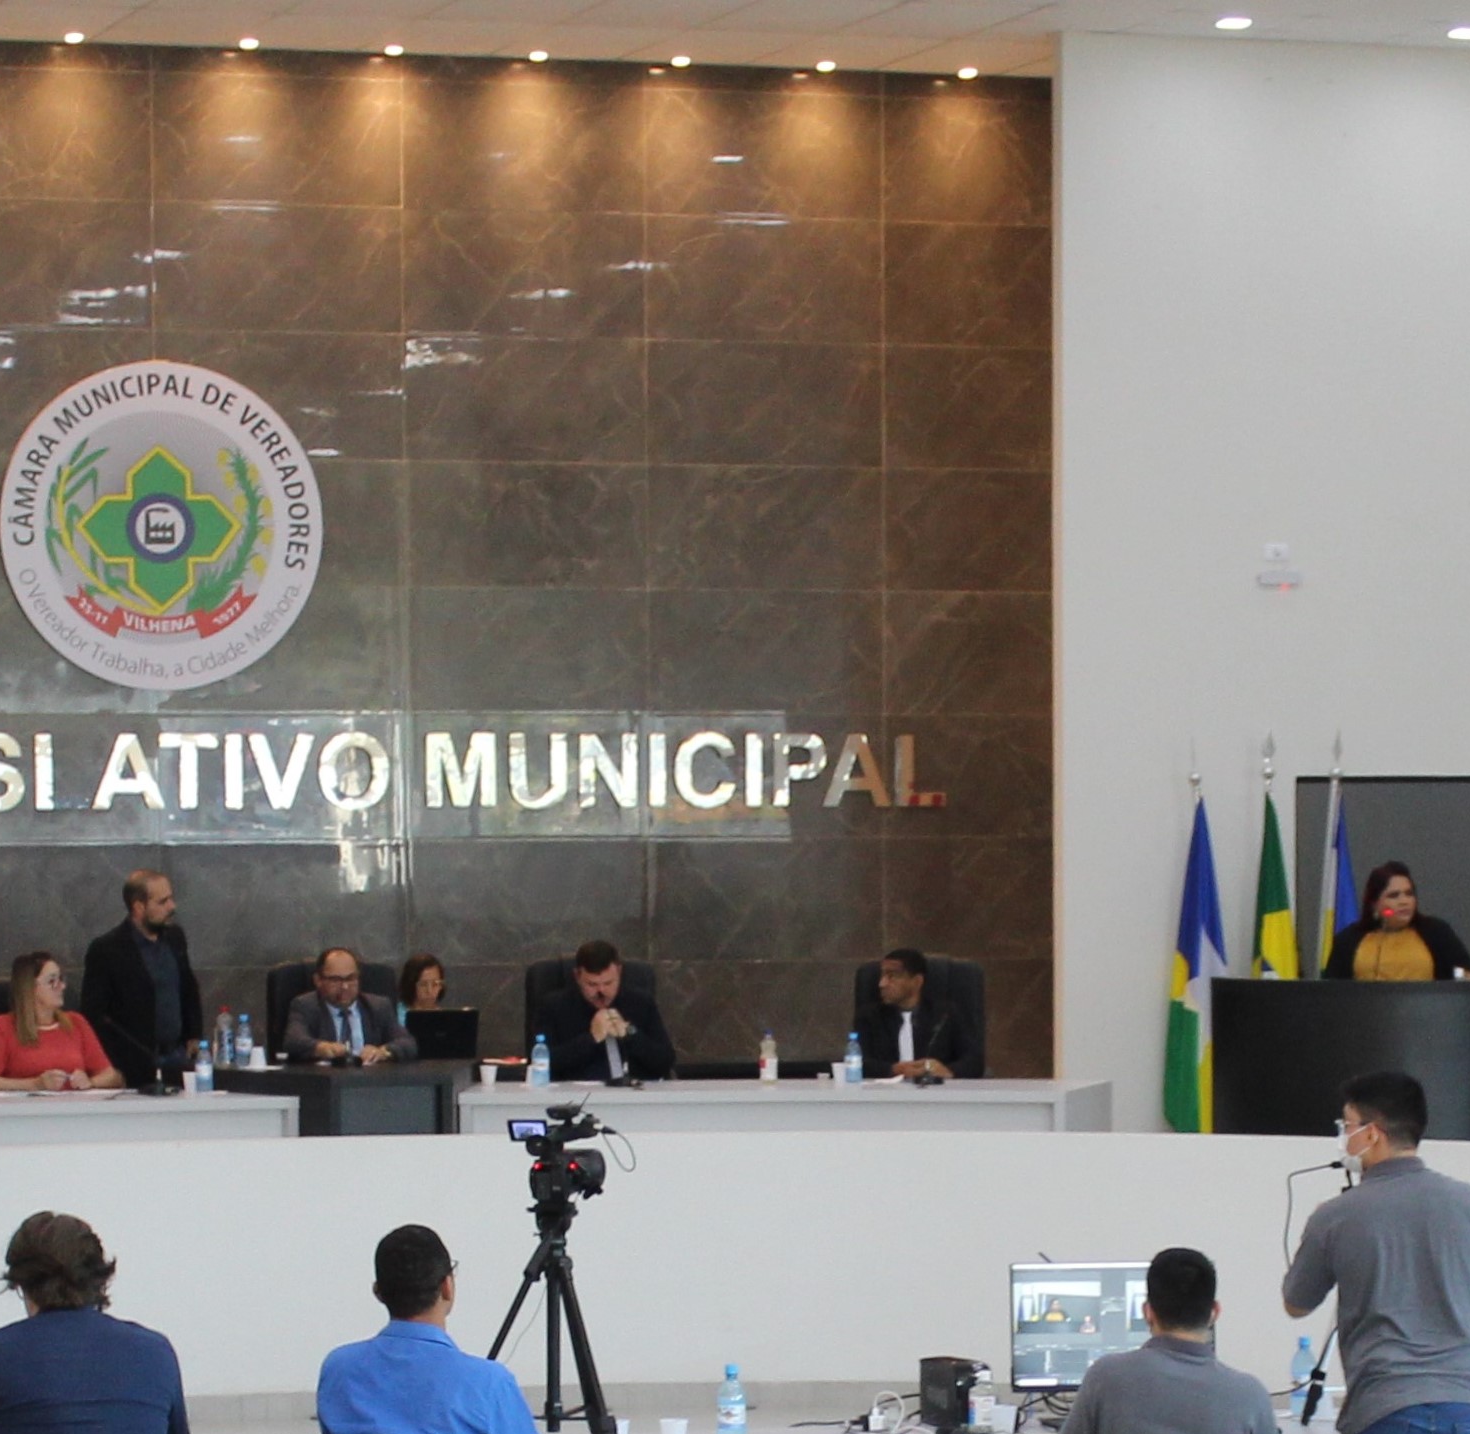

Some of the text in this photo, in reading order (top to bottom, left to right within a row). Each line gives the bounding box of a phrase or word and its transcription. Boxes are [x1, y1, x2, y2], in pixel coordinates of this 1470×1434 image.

[8, 373, 310, 572] CÂMARA MUNICIPAL DE VEREADORES
[28, 582, 91, 652] Vereador
[90, 642, 169, 680] Trabalha,
[174, 665, 184, 677] a
[187, 639, 248, 676] Cidade
[244, 583, 301, 642] Melhora
[123, 612, 196, 632] VILHENA
[424, 732, 947, 811] MUNICIPAL
